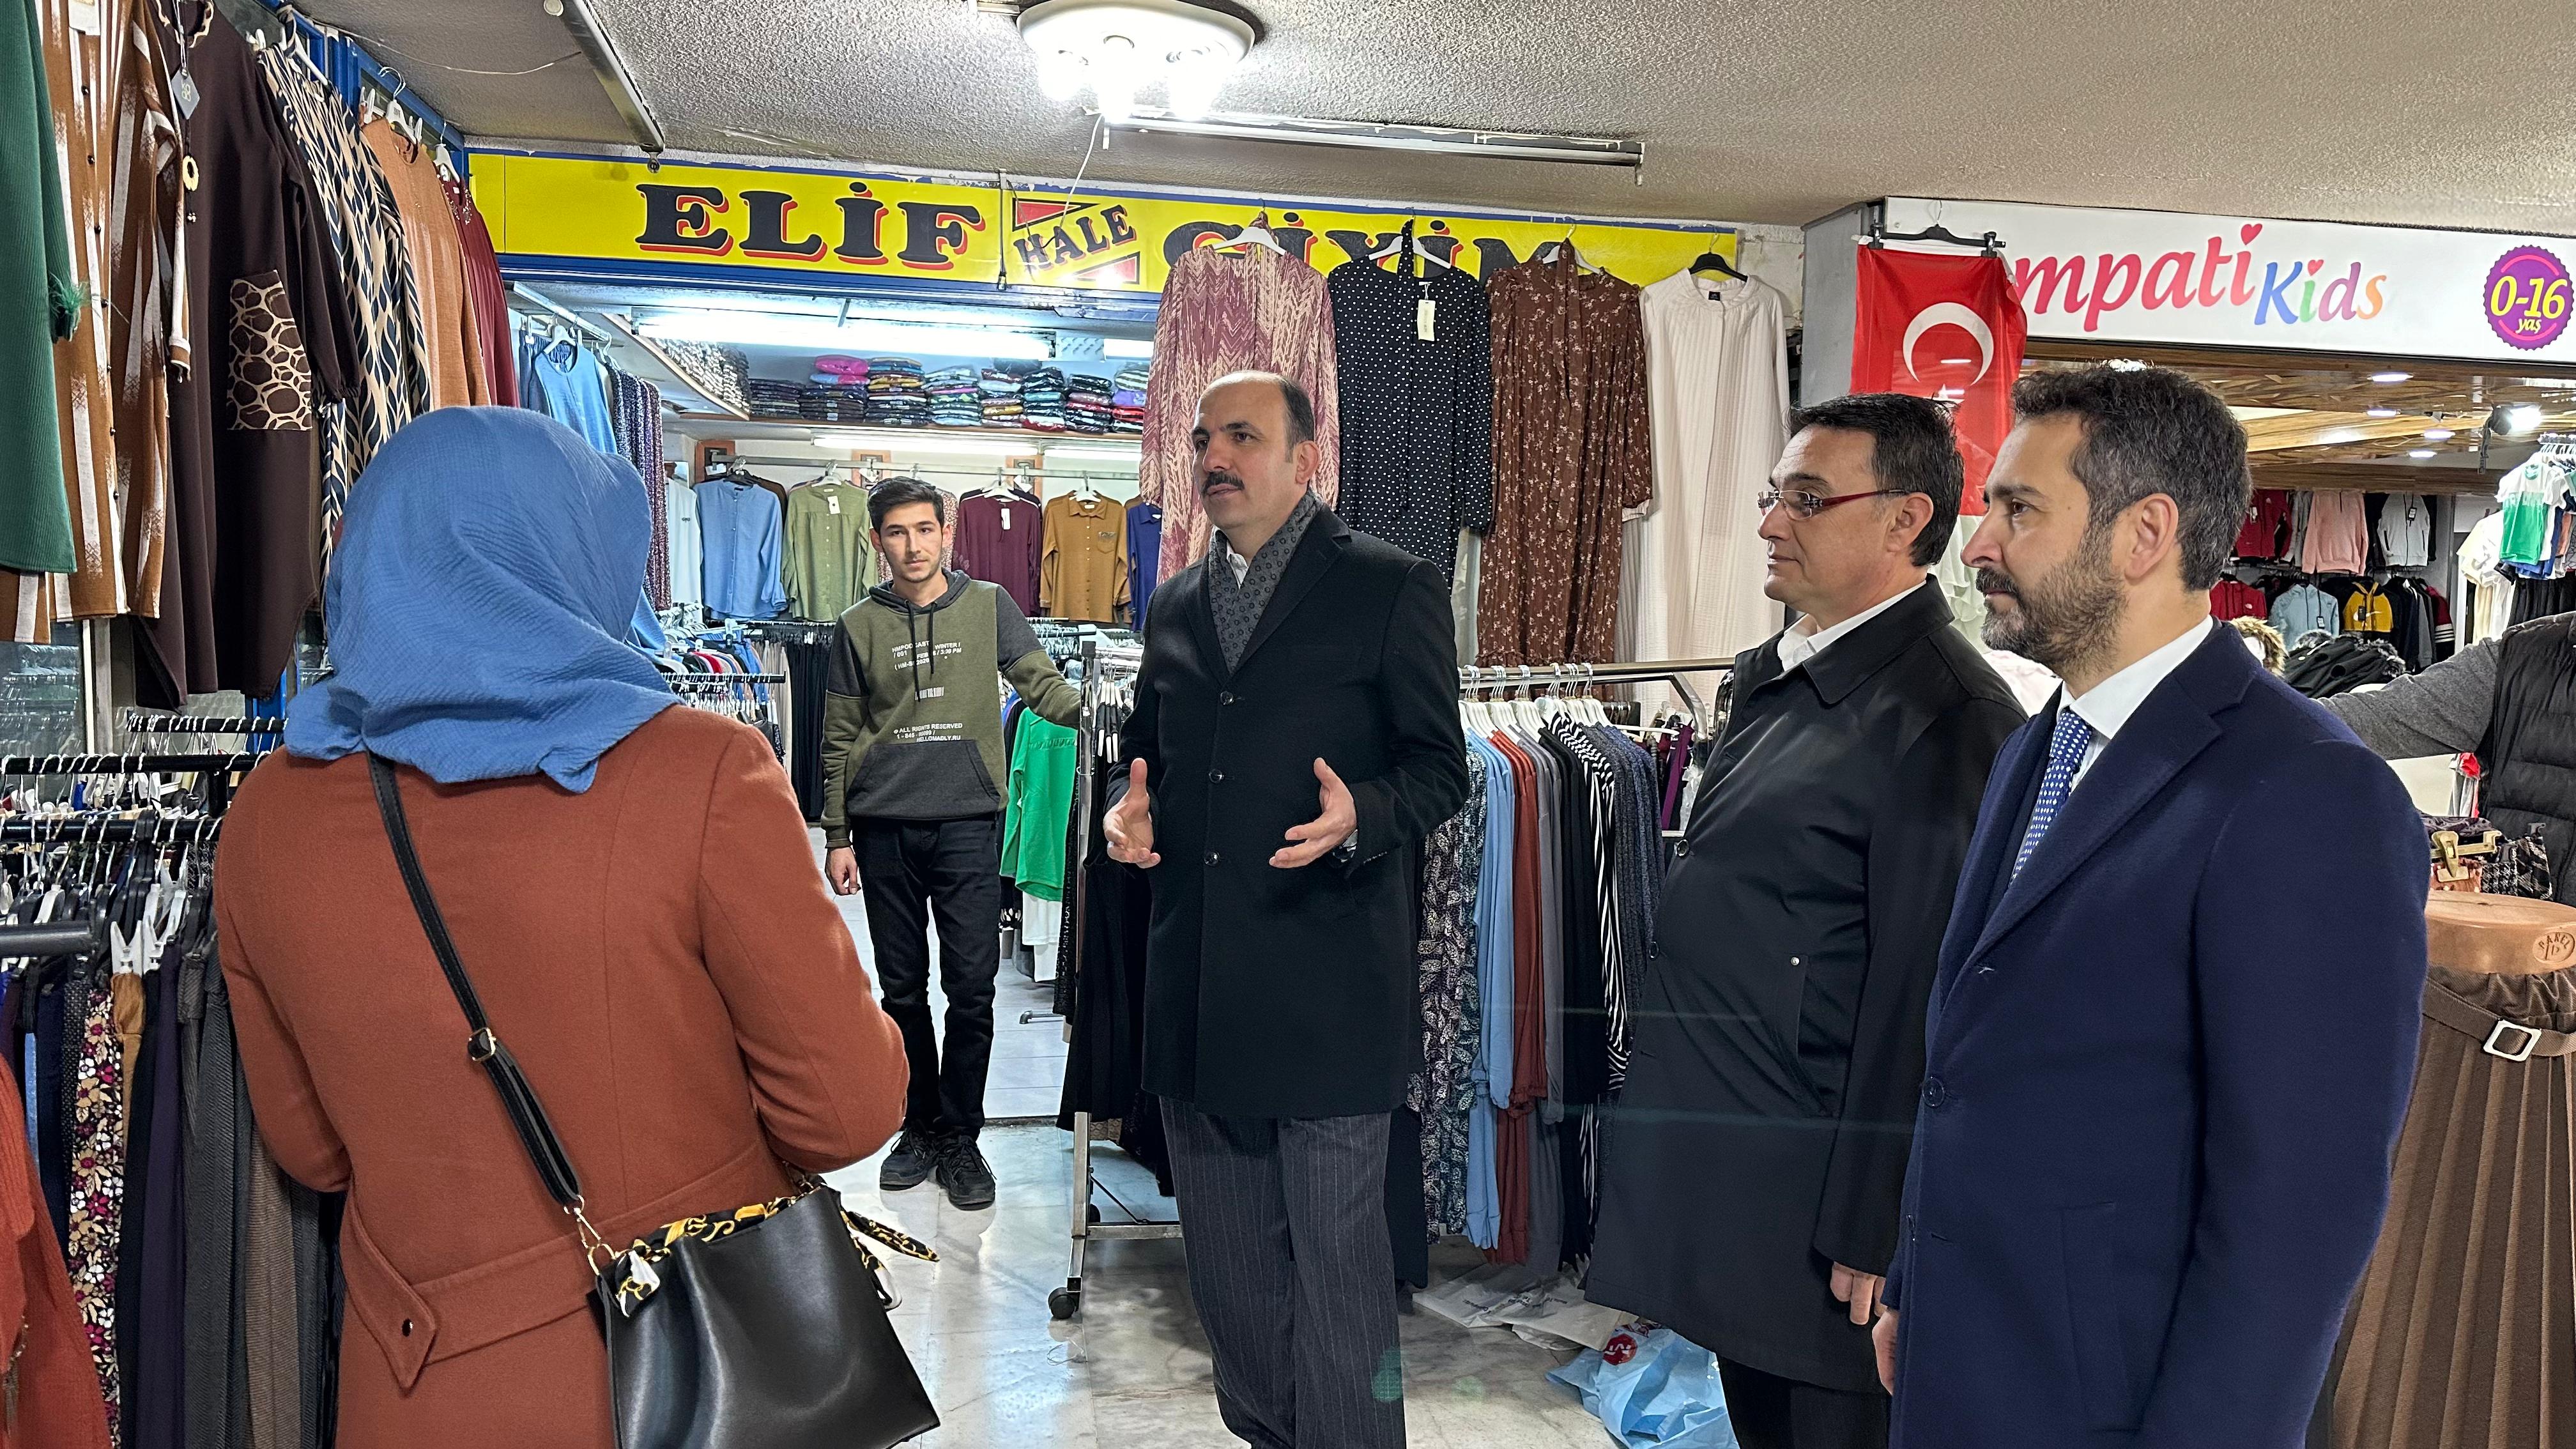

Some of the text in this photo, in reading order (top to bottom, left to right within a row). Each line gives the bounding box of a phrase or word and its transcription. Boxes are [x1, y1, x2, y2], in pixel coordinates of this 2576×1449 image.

[635, 181, 986, 270] ELİF
[1013, 204, 1137, 271] HALE
[2015, 224, 2387, 331] mpati Kids
[2491, 275, 2567, 319] 0-16
[2515, 318, 2542, 334] yaş
[892, 641, 930, 652] HMPODAST
[912, 724, 930, 732] RIGHTS
